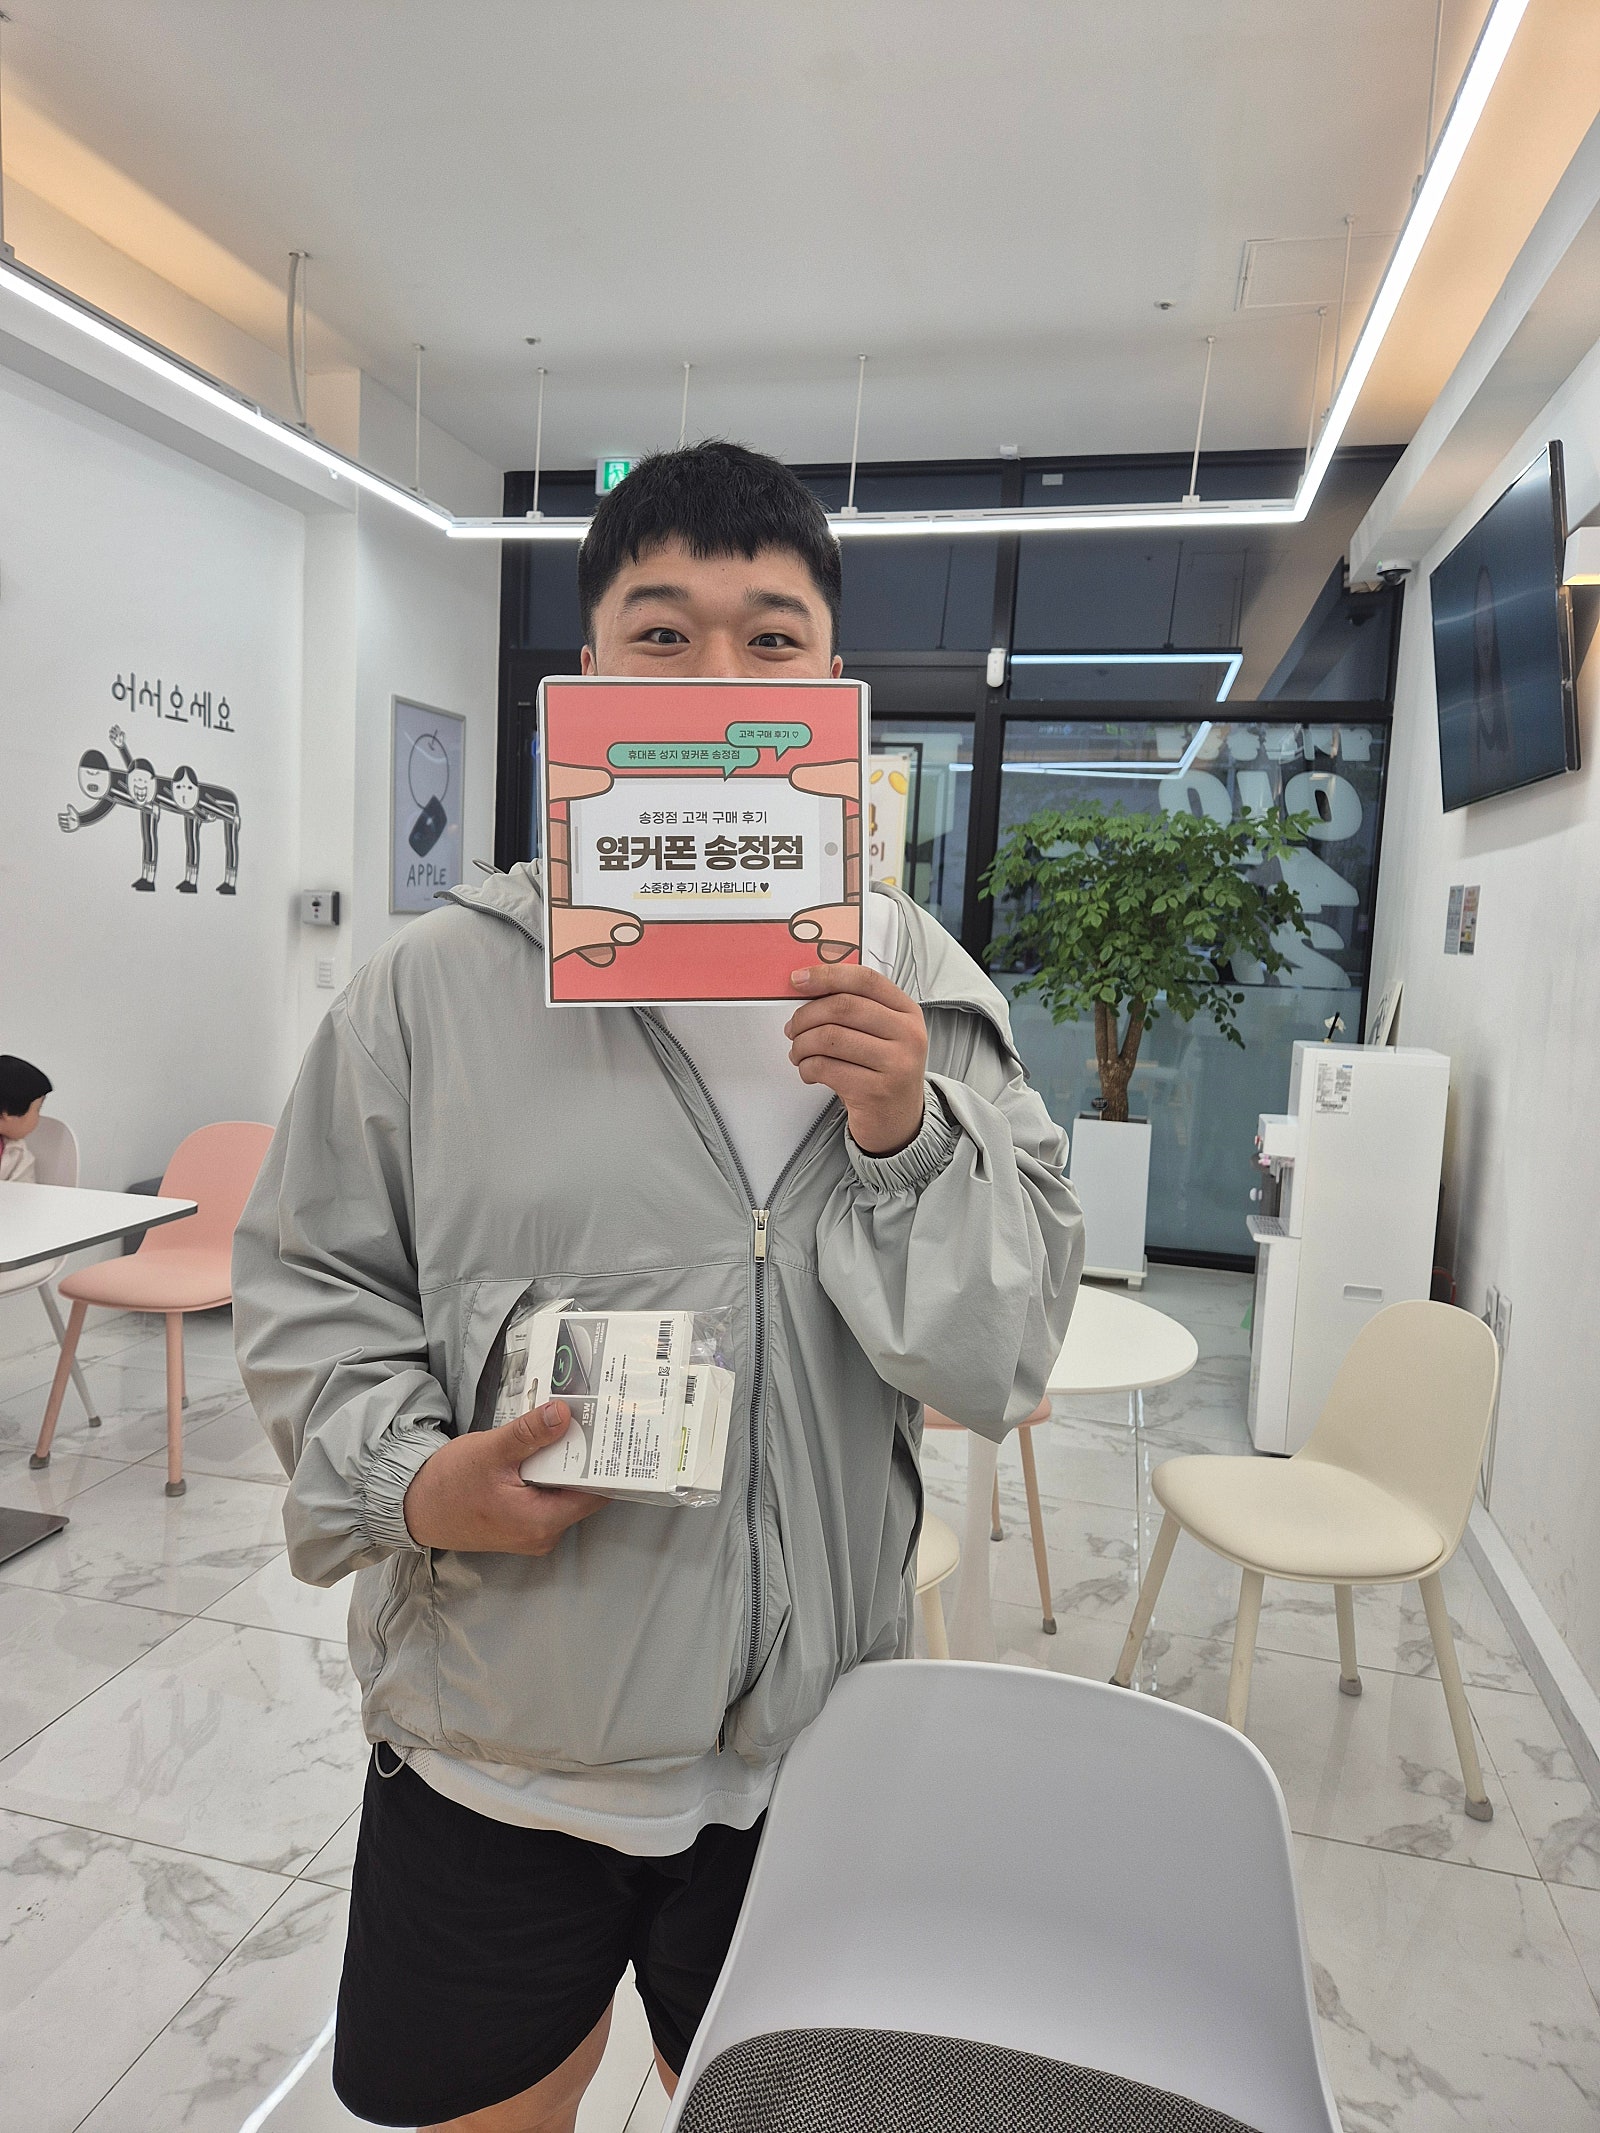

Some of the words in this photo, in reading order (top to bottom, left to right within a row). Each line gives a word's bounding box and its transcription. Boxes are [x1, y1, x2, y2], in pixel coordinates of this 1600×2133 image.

[111, 672, 235, 733] 어서오세요
[738, 730, 754, 739] 고객
[756, 730, 772, 739] 구매
[774, 730, 790, 739] 후기
[628, 750, 657, 760] 휴대폰
[659, 750, 678, 760] 성지
[681, 750, 709, 760] 옆커폰
[712, 750, 740, 760] 송정점
[639, 811, 678, 825] 송정점
[682, 811, 708, 824] 고객
[712, 811, 738, 824] 구매
[742, 811, 767, 824] 후기
[596, 835, 697, 871] 옆커폰
[704, 834, 803, 870] 송정점
[407, 862, 447, 888] APPLE
[640, 882, 674, 894] 소중한
[676, 882, 698, 894] 후기
[701, 881, 757, 894] 감사합니다
[582, 1402, 591, 1426] 15W
